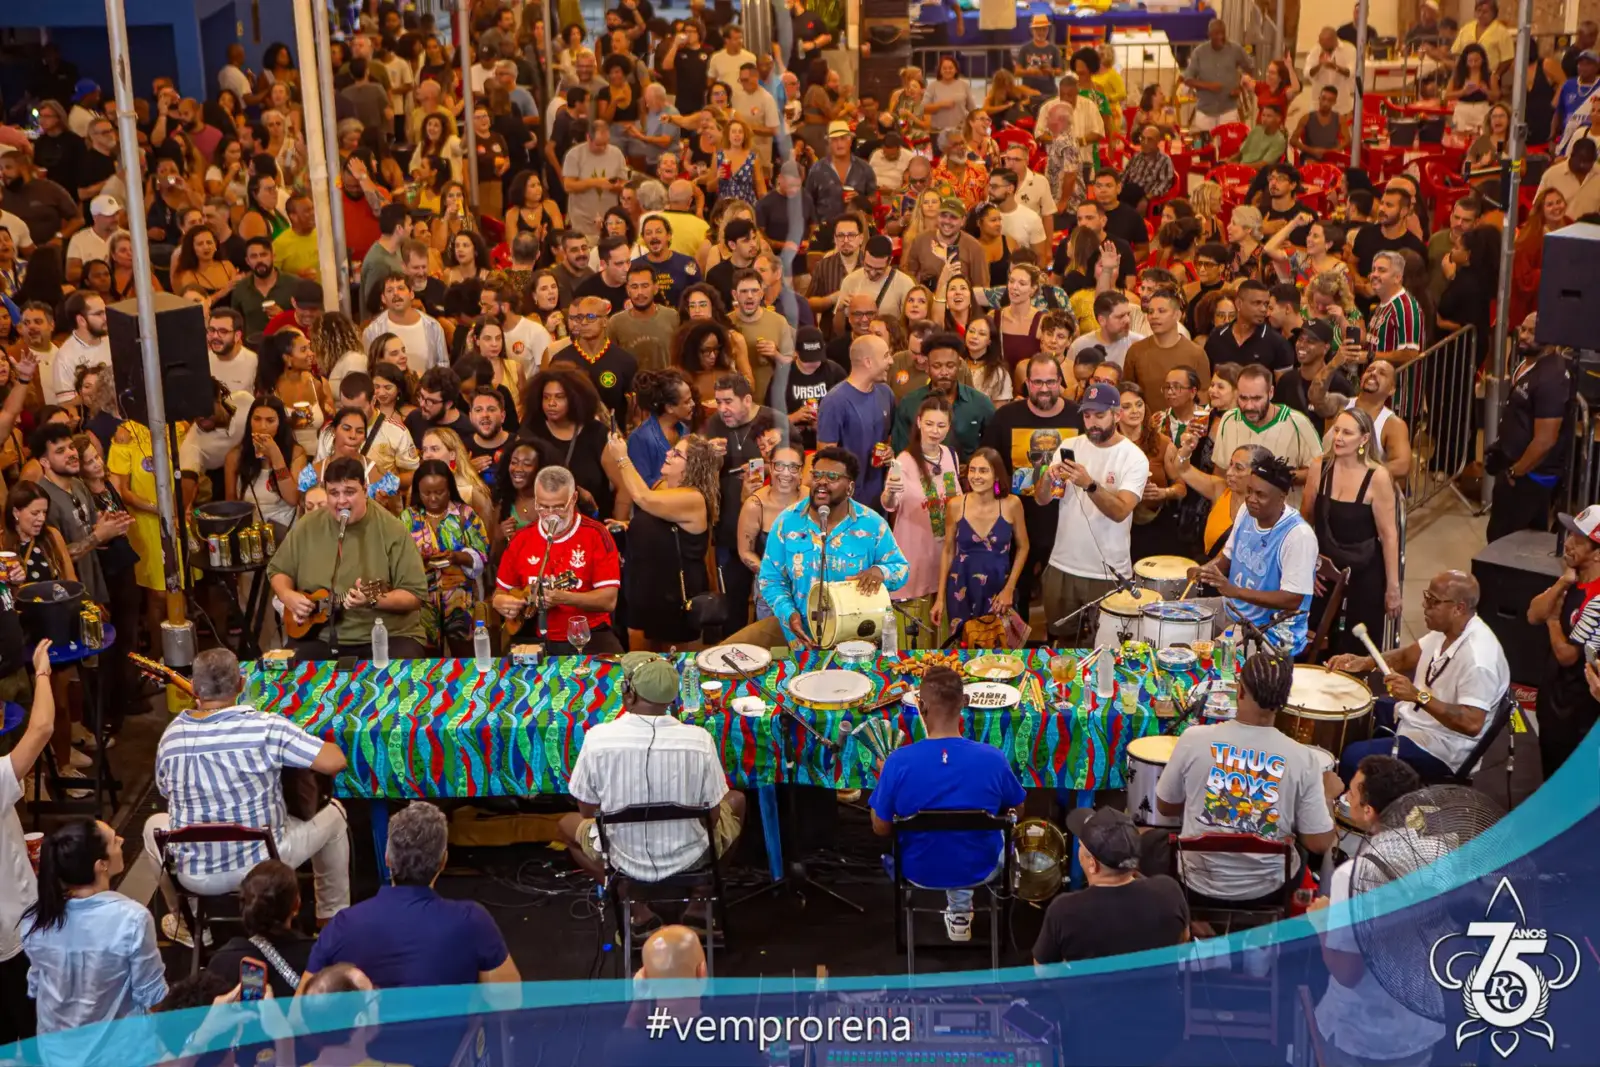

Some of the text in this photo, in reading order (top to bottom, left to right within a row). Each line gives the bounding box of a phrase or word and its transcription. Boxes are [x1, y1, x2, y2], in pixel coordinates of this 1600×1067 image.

[793, 382, 828, 400] VASCO
[972, 691, 1007, 700] SAMBA
[1210, 741, 1287, 779] THUG
[1206, 765, 1280, 803] BOYS
